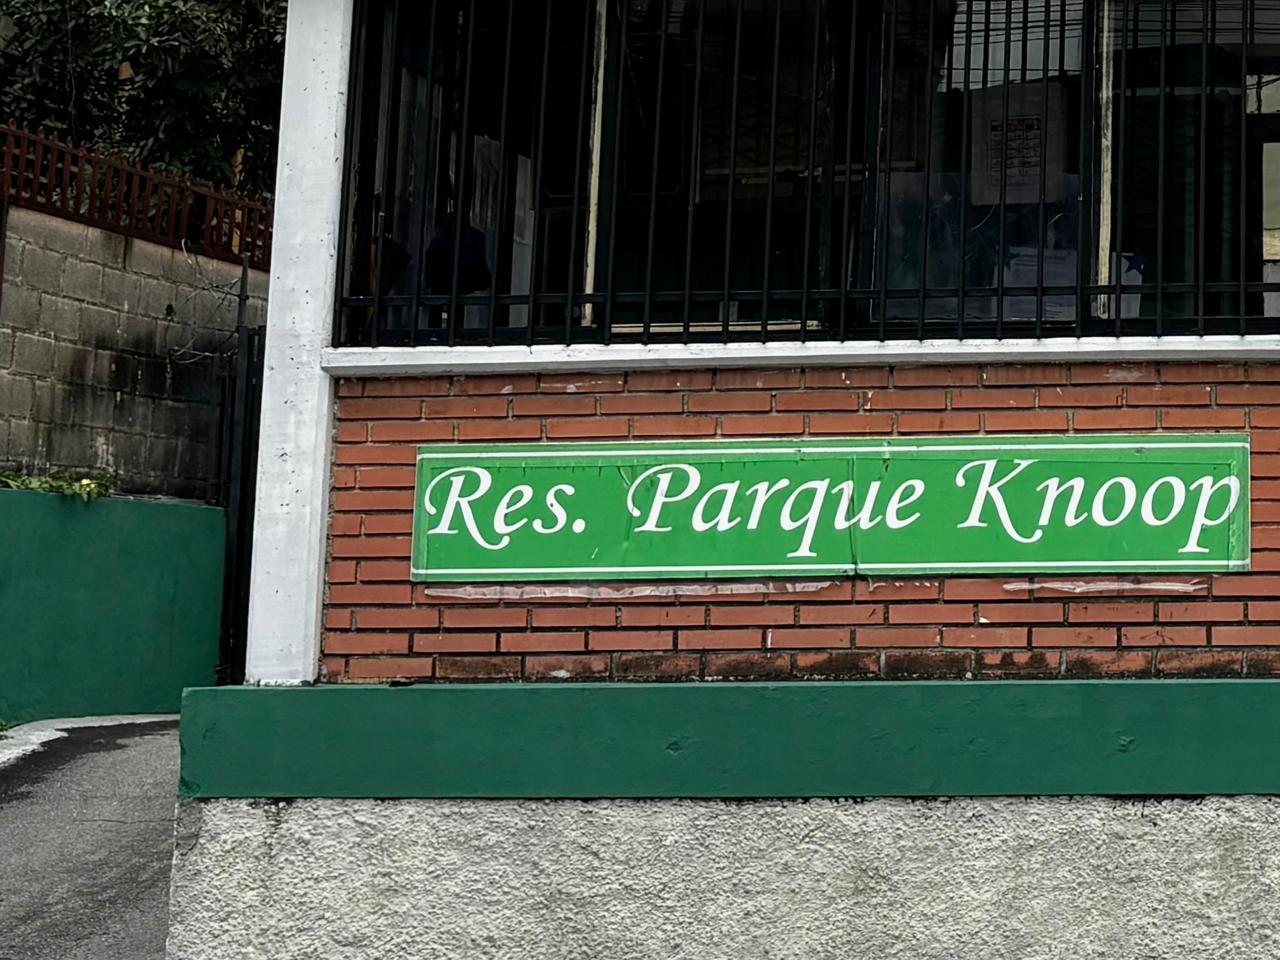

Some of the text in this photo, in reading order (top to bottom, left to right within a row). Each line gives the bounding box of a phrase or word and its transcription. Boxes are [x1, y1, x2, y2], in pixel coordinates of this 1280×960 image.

[424, 458, 1242, 557] Res. Parque Knoop
